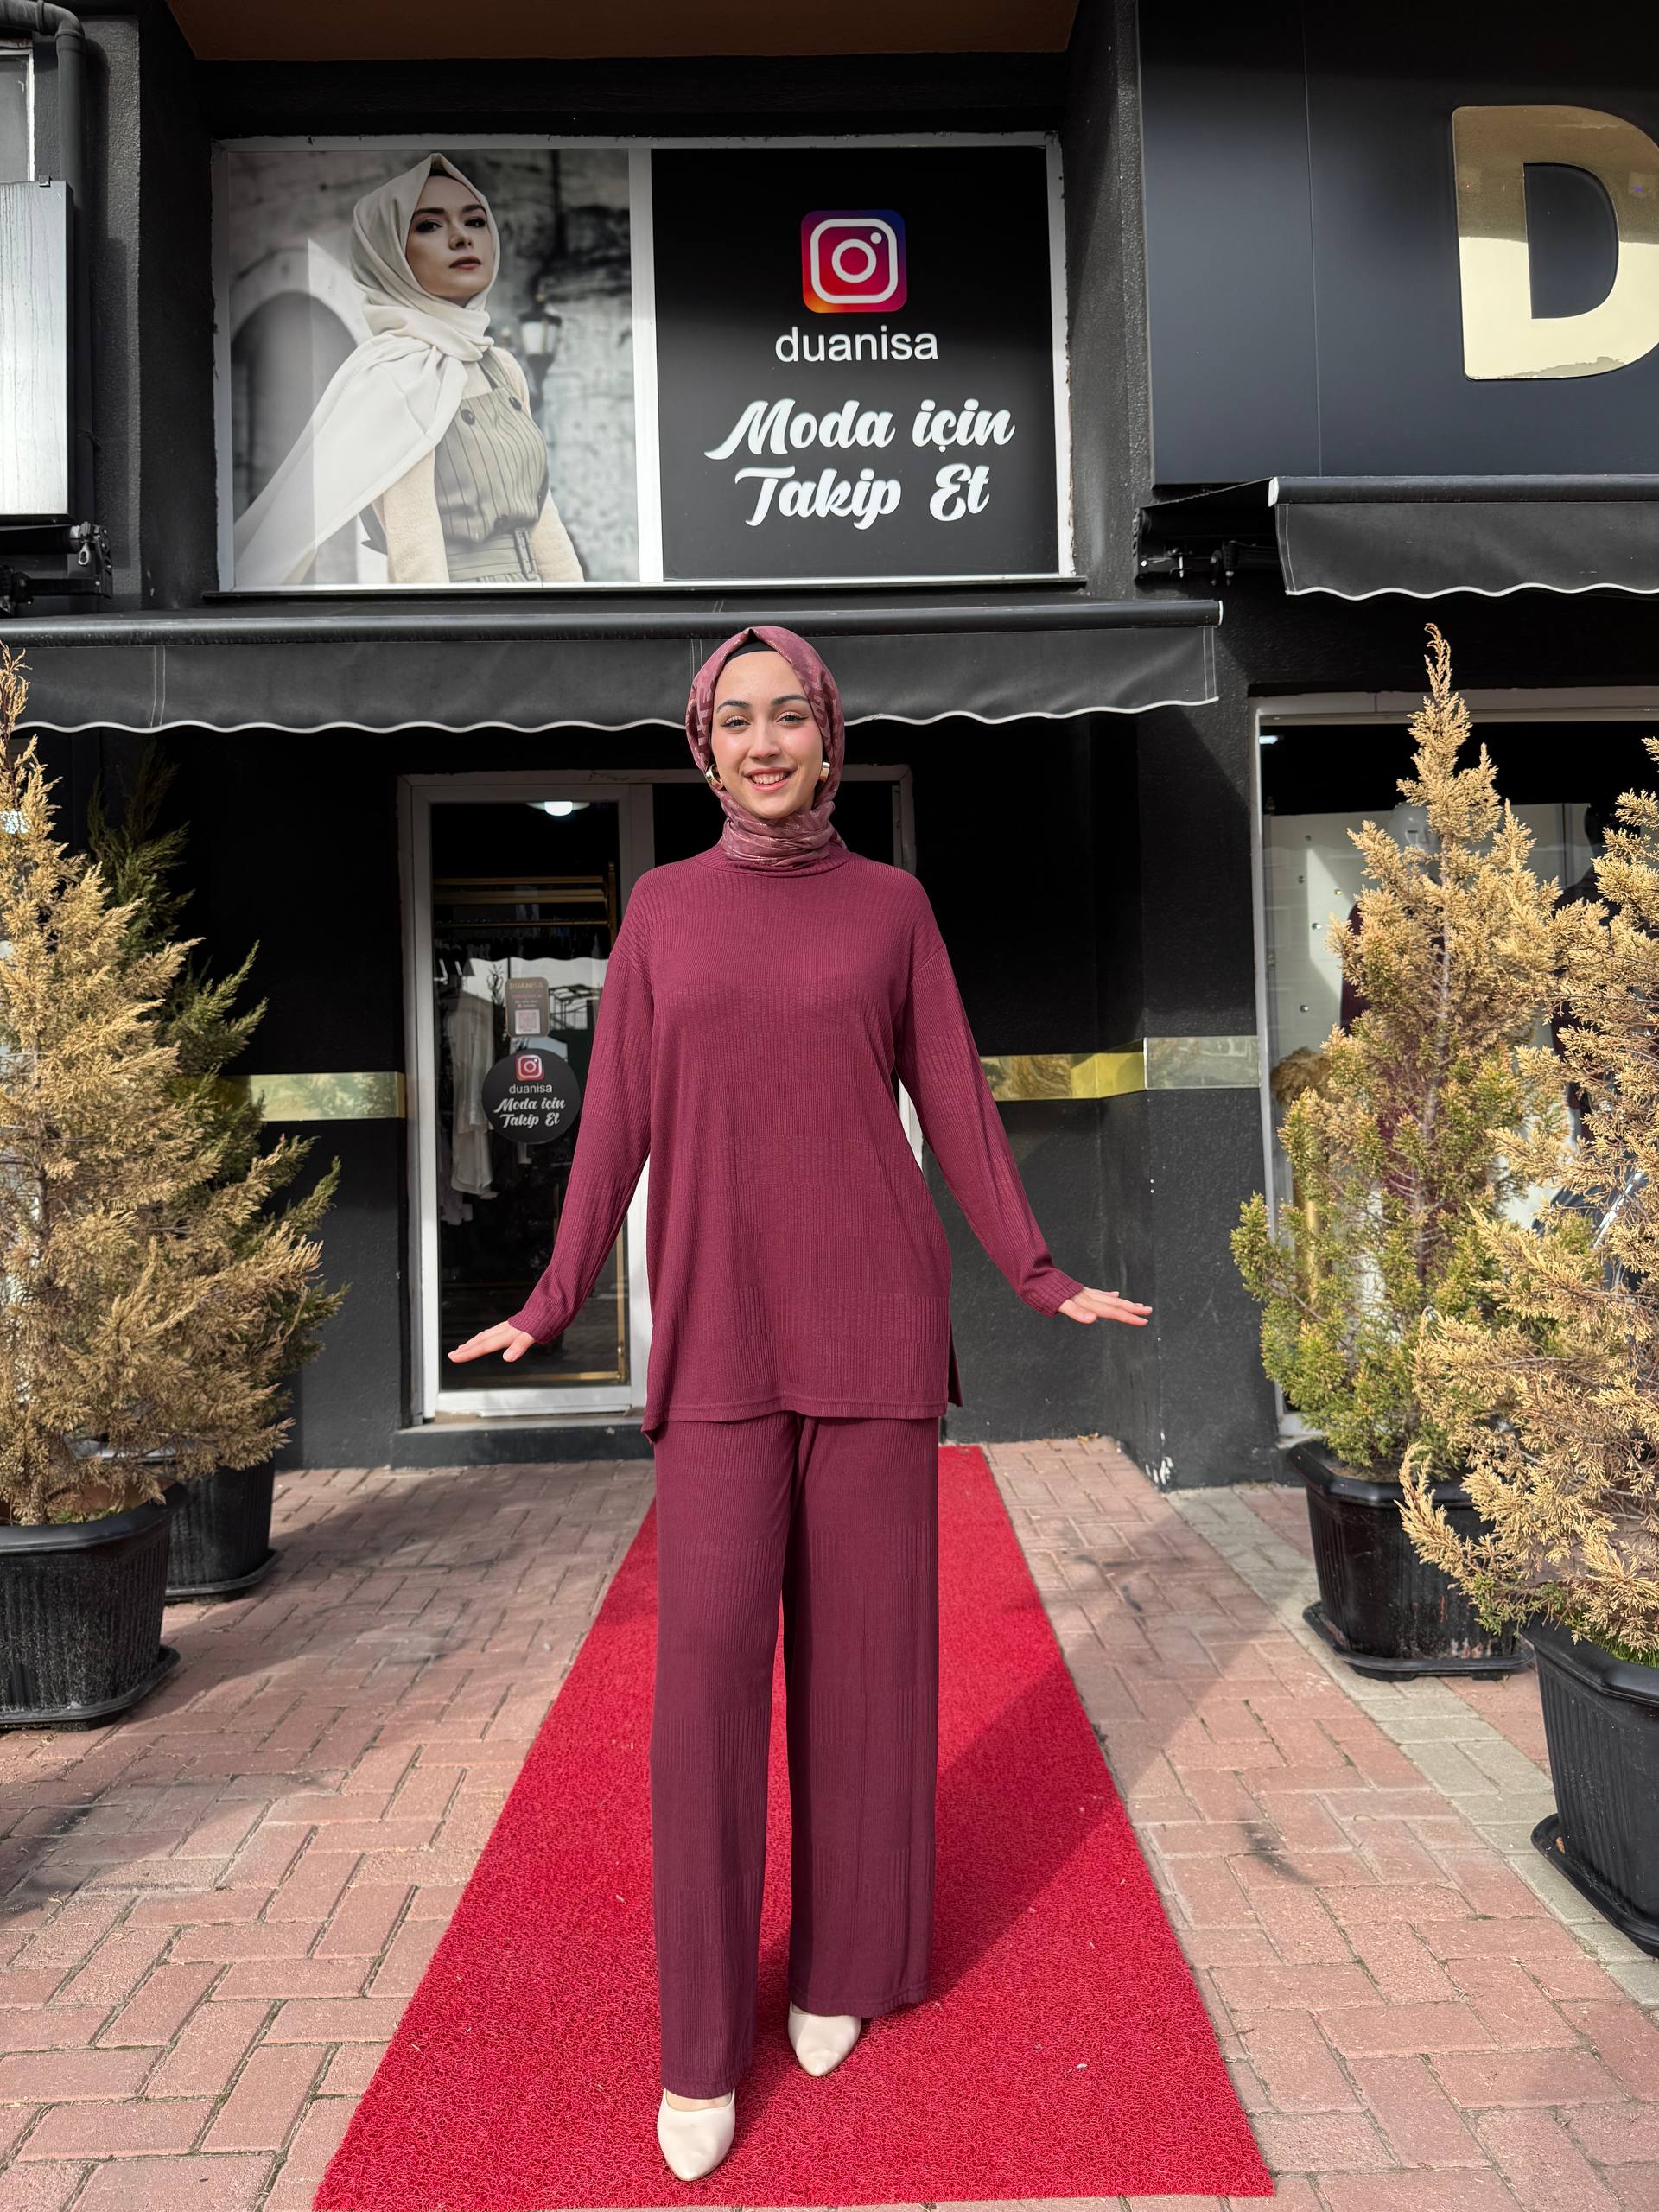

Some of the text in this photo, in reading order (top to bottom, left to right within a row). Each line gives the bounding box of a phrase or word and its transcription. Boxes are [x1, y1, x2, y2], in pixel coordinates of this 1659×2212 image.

[1452, 105, 1659, 380] D
[775, 325, 938, 362] duanisa
[704, 398, 1015, 460] Moda için
[734, 463, 990, 530] Takip Et
[493, 1096, 566, 1113] Moda için
[508, 1083, 553, 1094] duanisa
[499, 1113, 540, 1128] Takip
